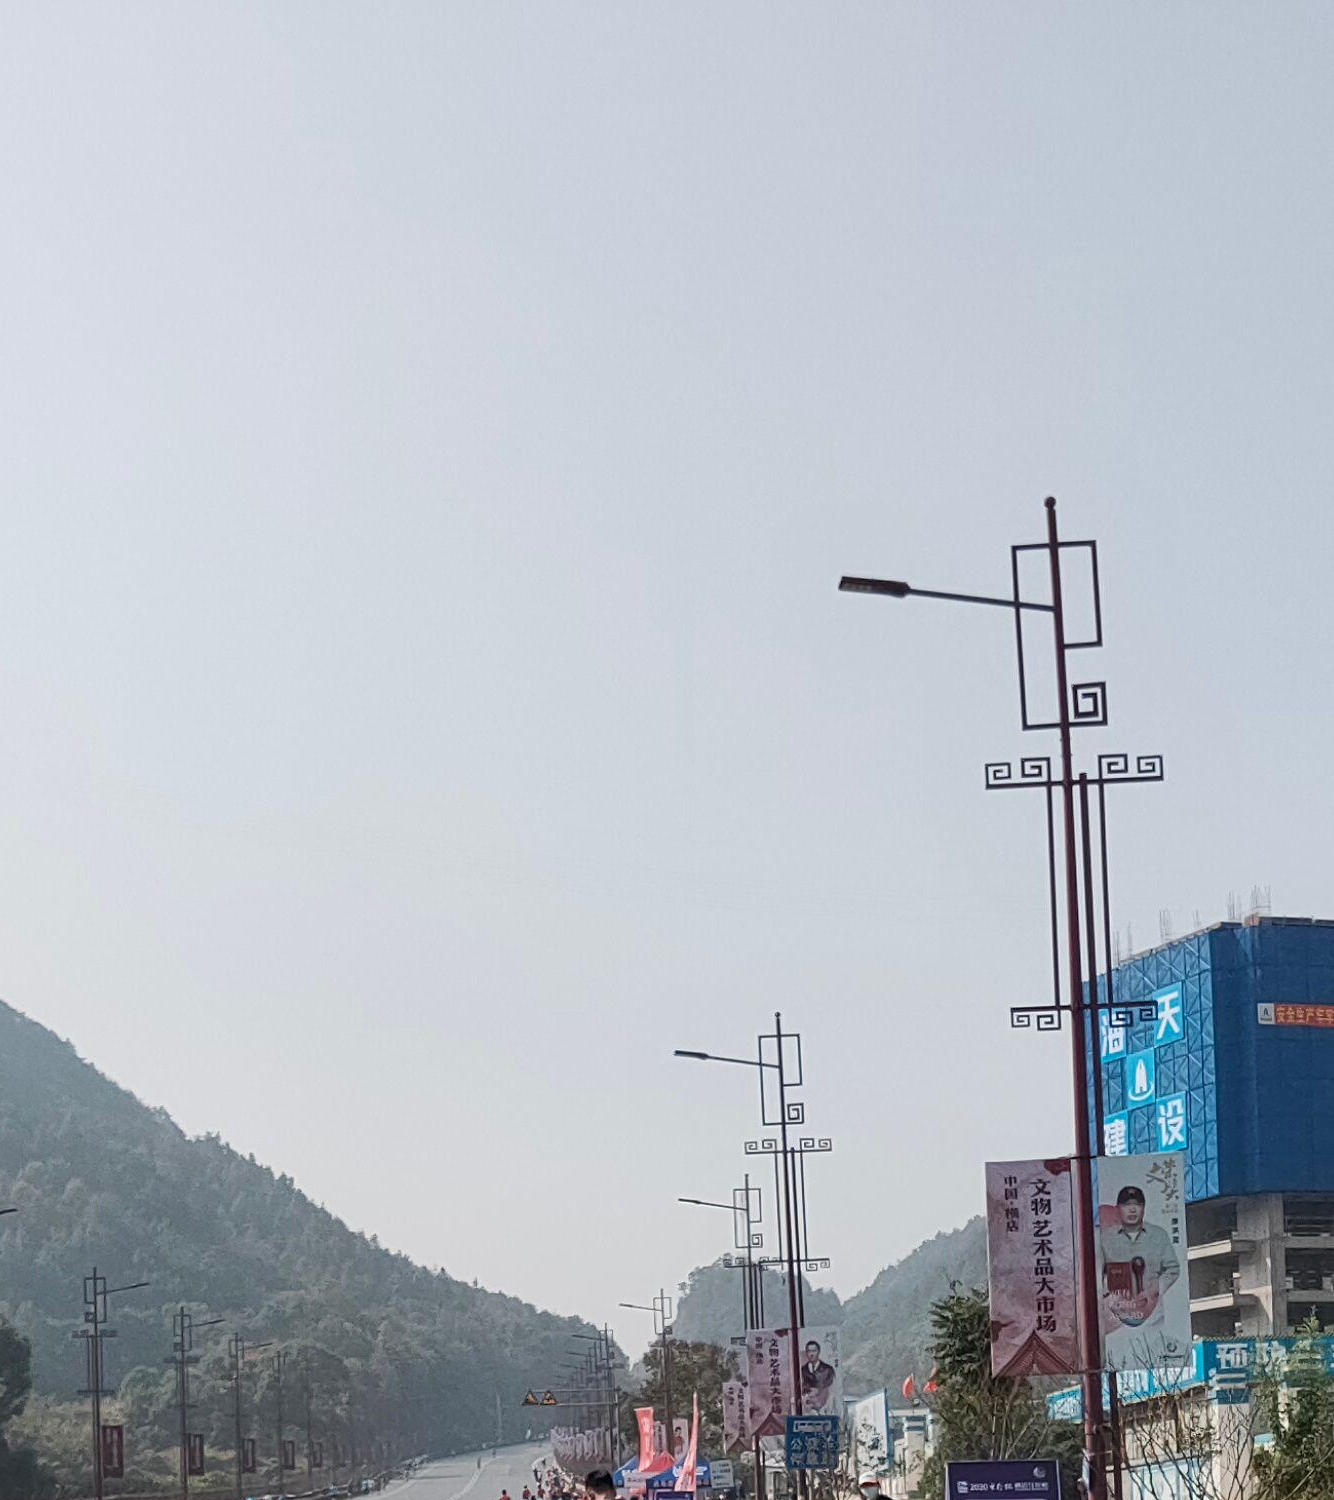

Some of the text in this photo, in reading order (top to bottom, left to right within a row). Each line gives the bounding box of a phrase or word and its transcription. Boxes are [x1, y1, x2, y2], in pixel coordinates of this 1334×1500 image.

[1030, 1178, 1057, 1333] 文物艺术品大市场
